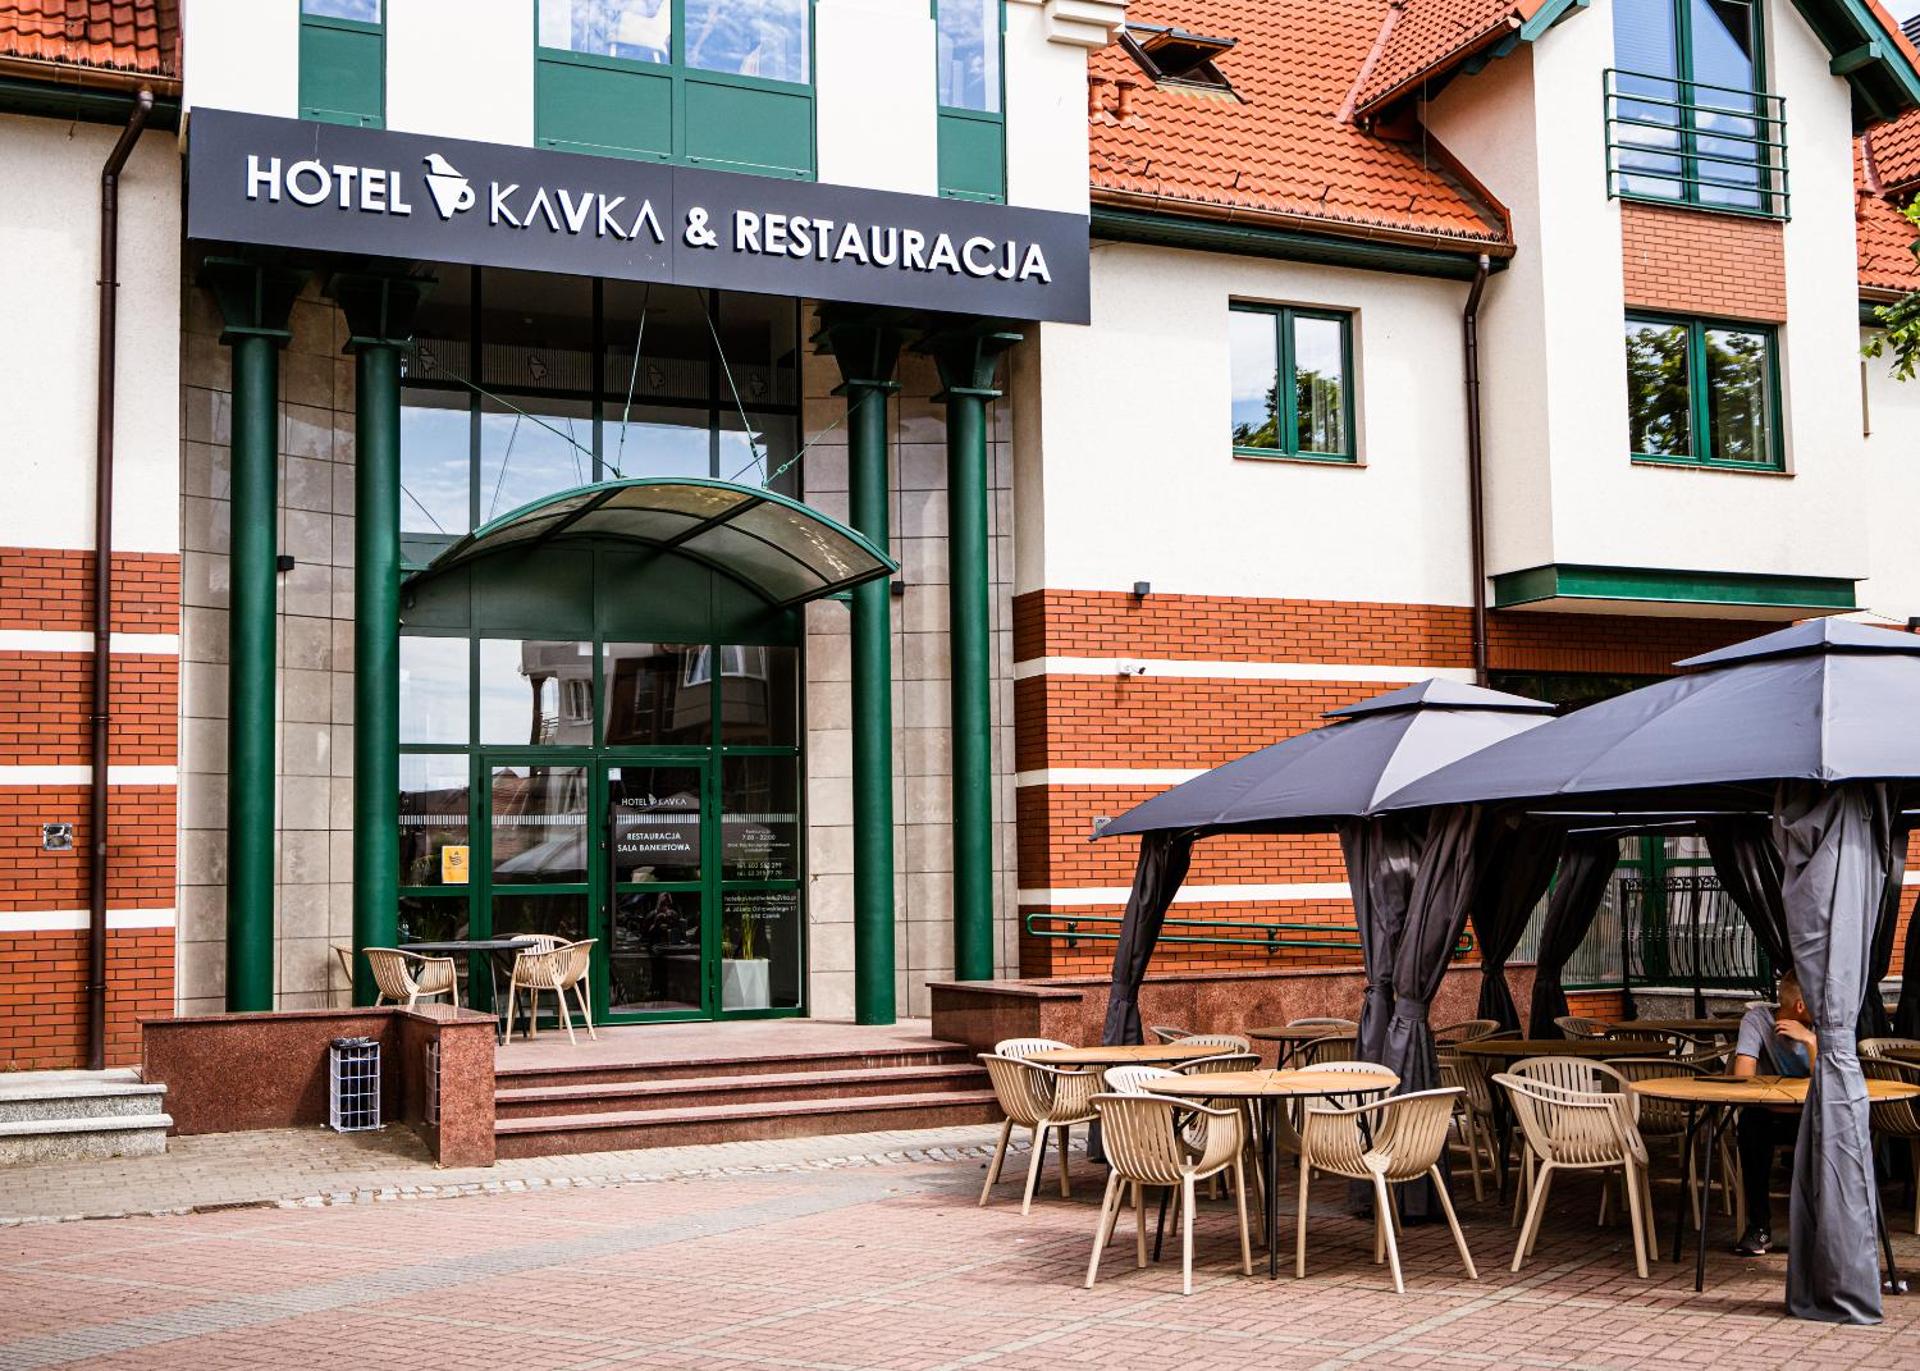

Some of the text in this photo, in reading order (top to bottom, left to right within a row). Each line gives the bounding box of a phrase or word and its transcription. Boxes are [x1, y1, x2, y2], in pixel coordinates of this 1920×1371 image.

[246, 154, 1052, 283] HOTEL KAVKA & RESTAURACJA
[621, 798, 647, 806] HOTEL
[626, 832, 681, 841] RESTAURACJA
[617, 843, 691, 852] SALA BANKIETOWA
